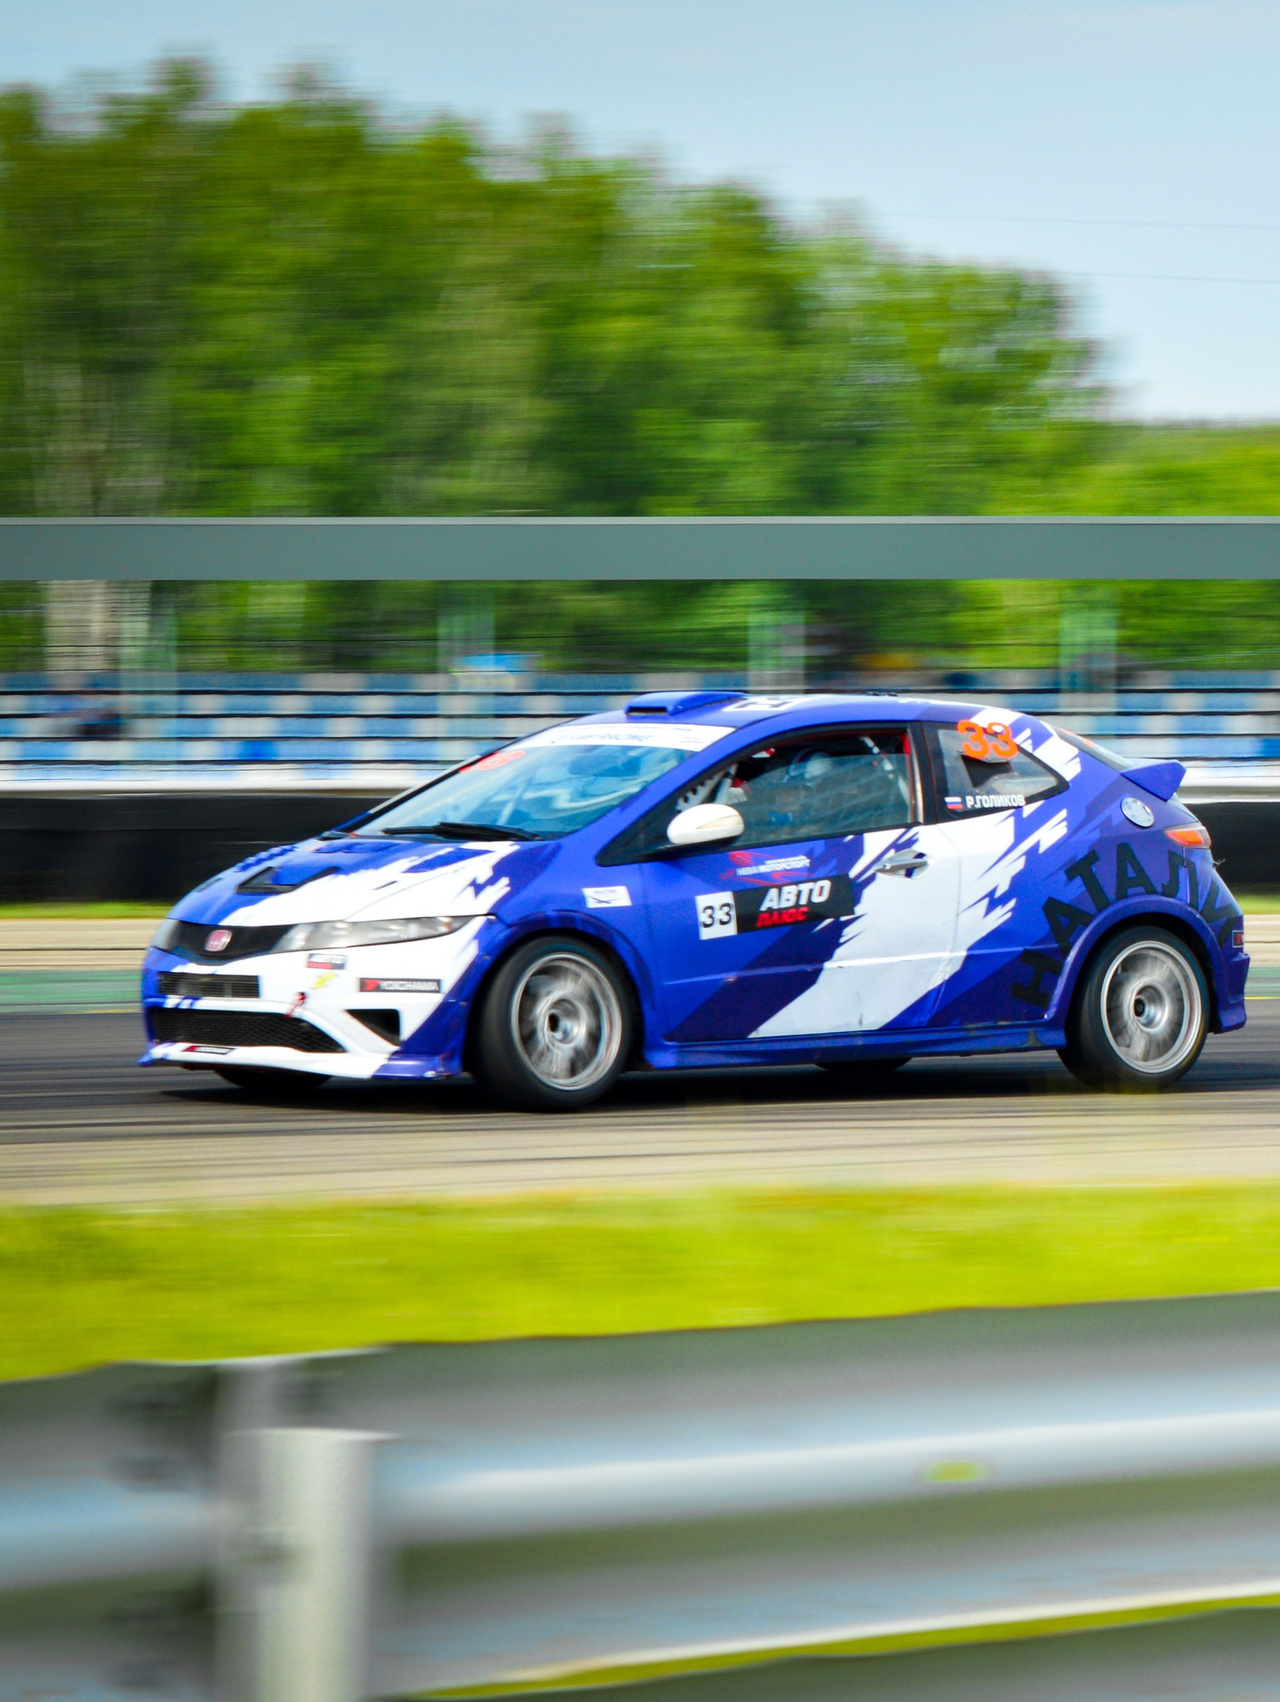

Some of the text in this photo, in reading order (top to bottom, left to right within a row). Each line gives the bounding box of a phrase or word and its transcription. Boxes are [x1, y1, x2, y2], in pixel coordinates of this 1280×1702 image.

[957, 719, 1019, 759] 33
[966, 794, 1026, 809] Р.ГОЛИКОВ
[760, 880, 831, 911] АВТО
[702, 903, 733, 928] 33
[756, 907, 809, 928] ПЛЮС
